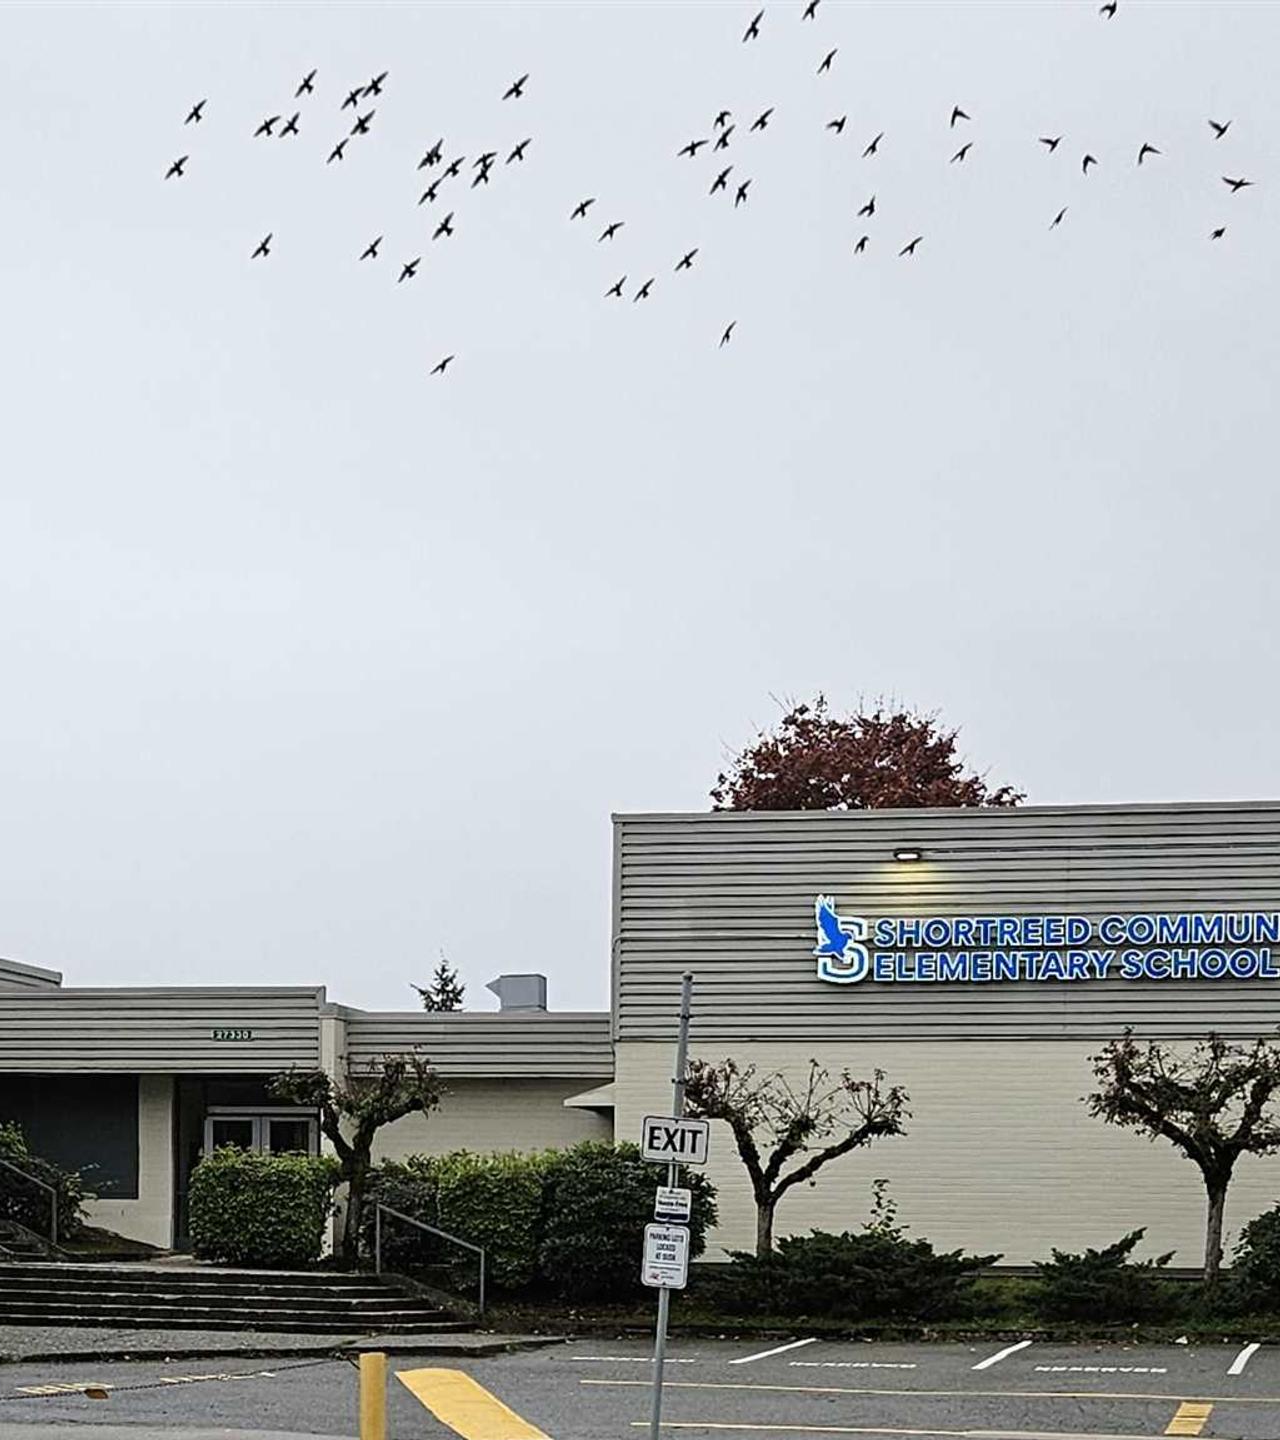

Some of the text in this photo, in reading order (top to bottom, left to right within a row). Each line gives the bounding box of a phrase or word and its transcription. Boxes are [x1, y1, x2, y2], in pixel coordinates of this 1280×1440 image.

[873, 915, 1093, 947] SHORTREED
[873, 948, 1280, 982] ELEMENTARY SCHOOL
[648, 1126, 703, 1154] EXIT
